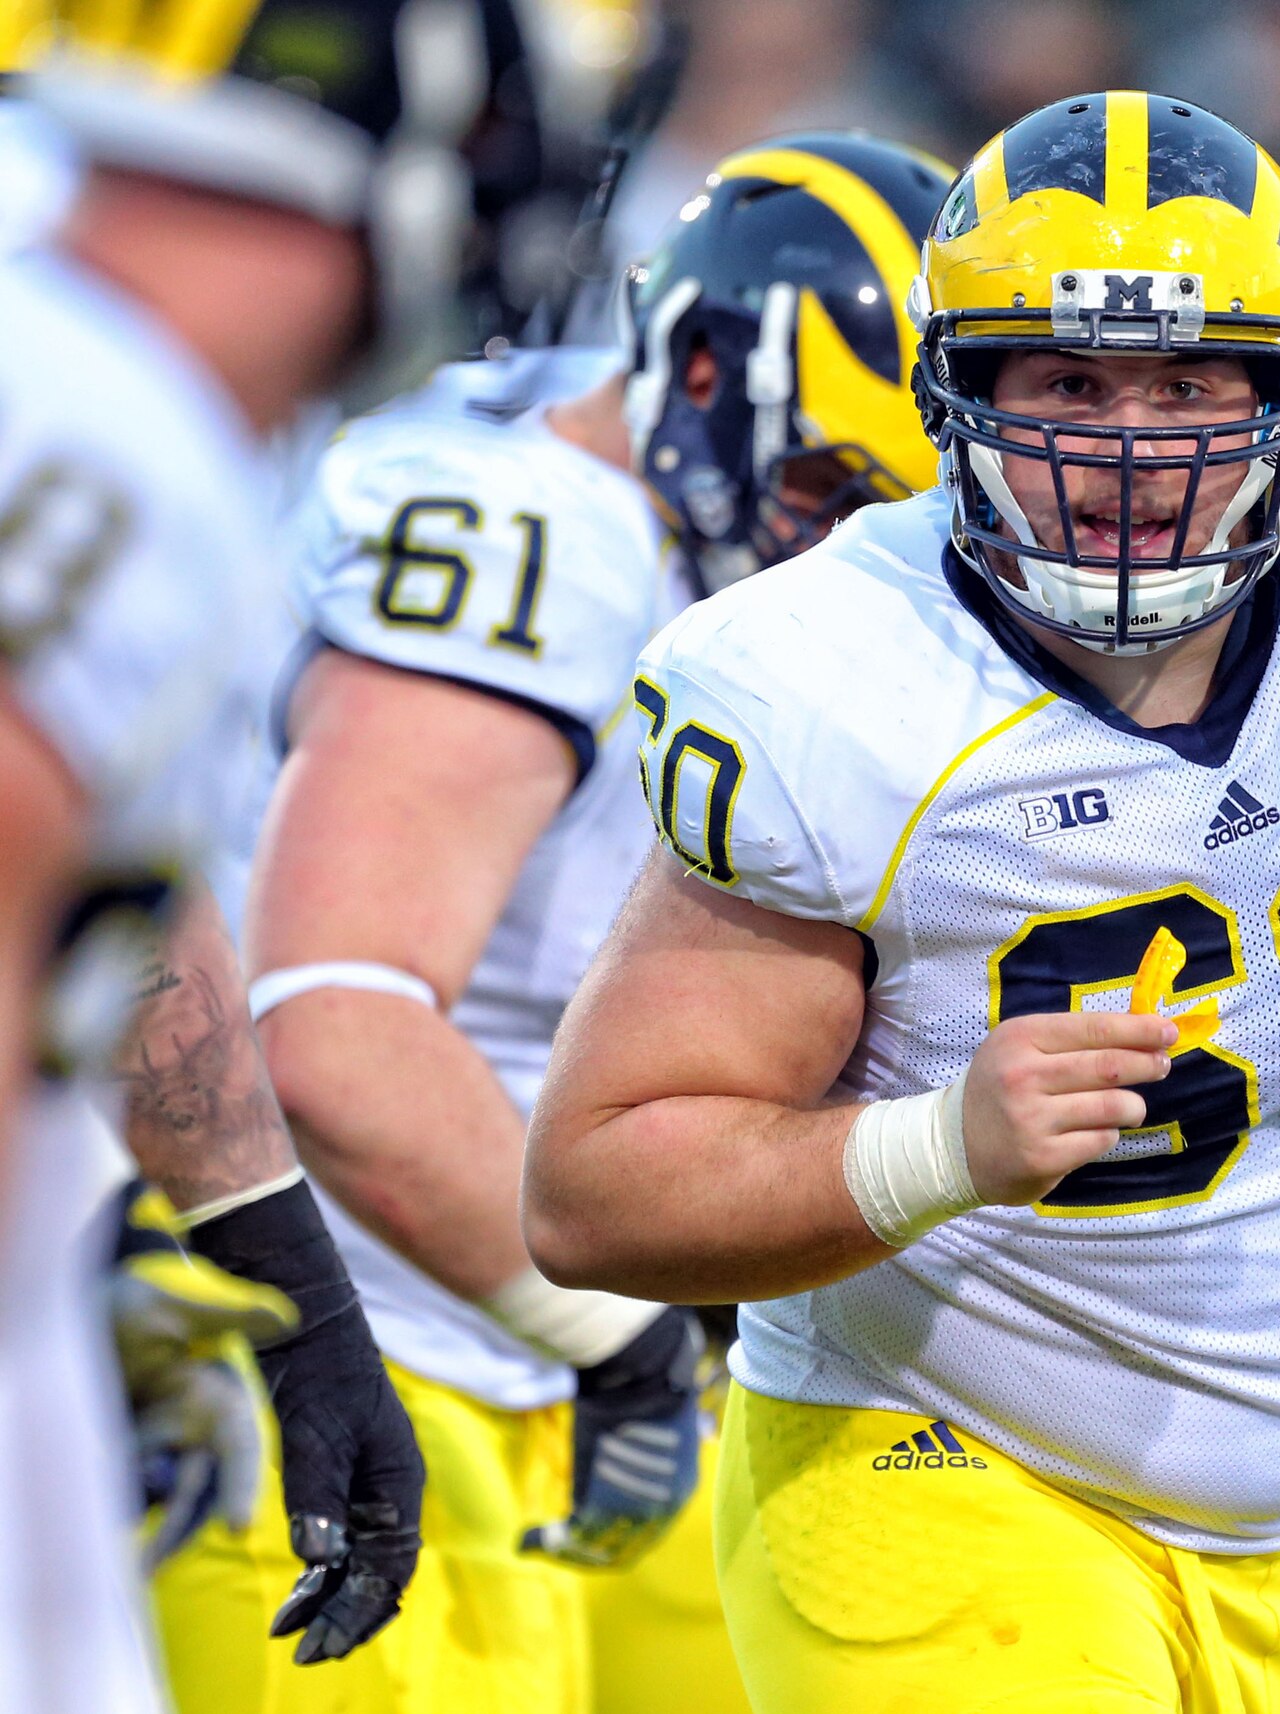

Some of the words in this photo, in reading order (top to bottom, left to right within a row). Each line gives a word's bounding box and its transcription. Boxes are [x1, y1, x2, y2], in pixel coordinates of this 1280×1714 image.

[1104, 275, 1153, 310] M
[371, 497, 547, 661] 61
[1104, 612, 1159, 626] Rdell
[1203, 806, 1280, 850] adidas
[872, 1451, 988, 1471] adidas
